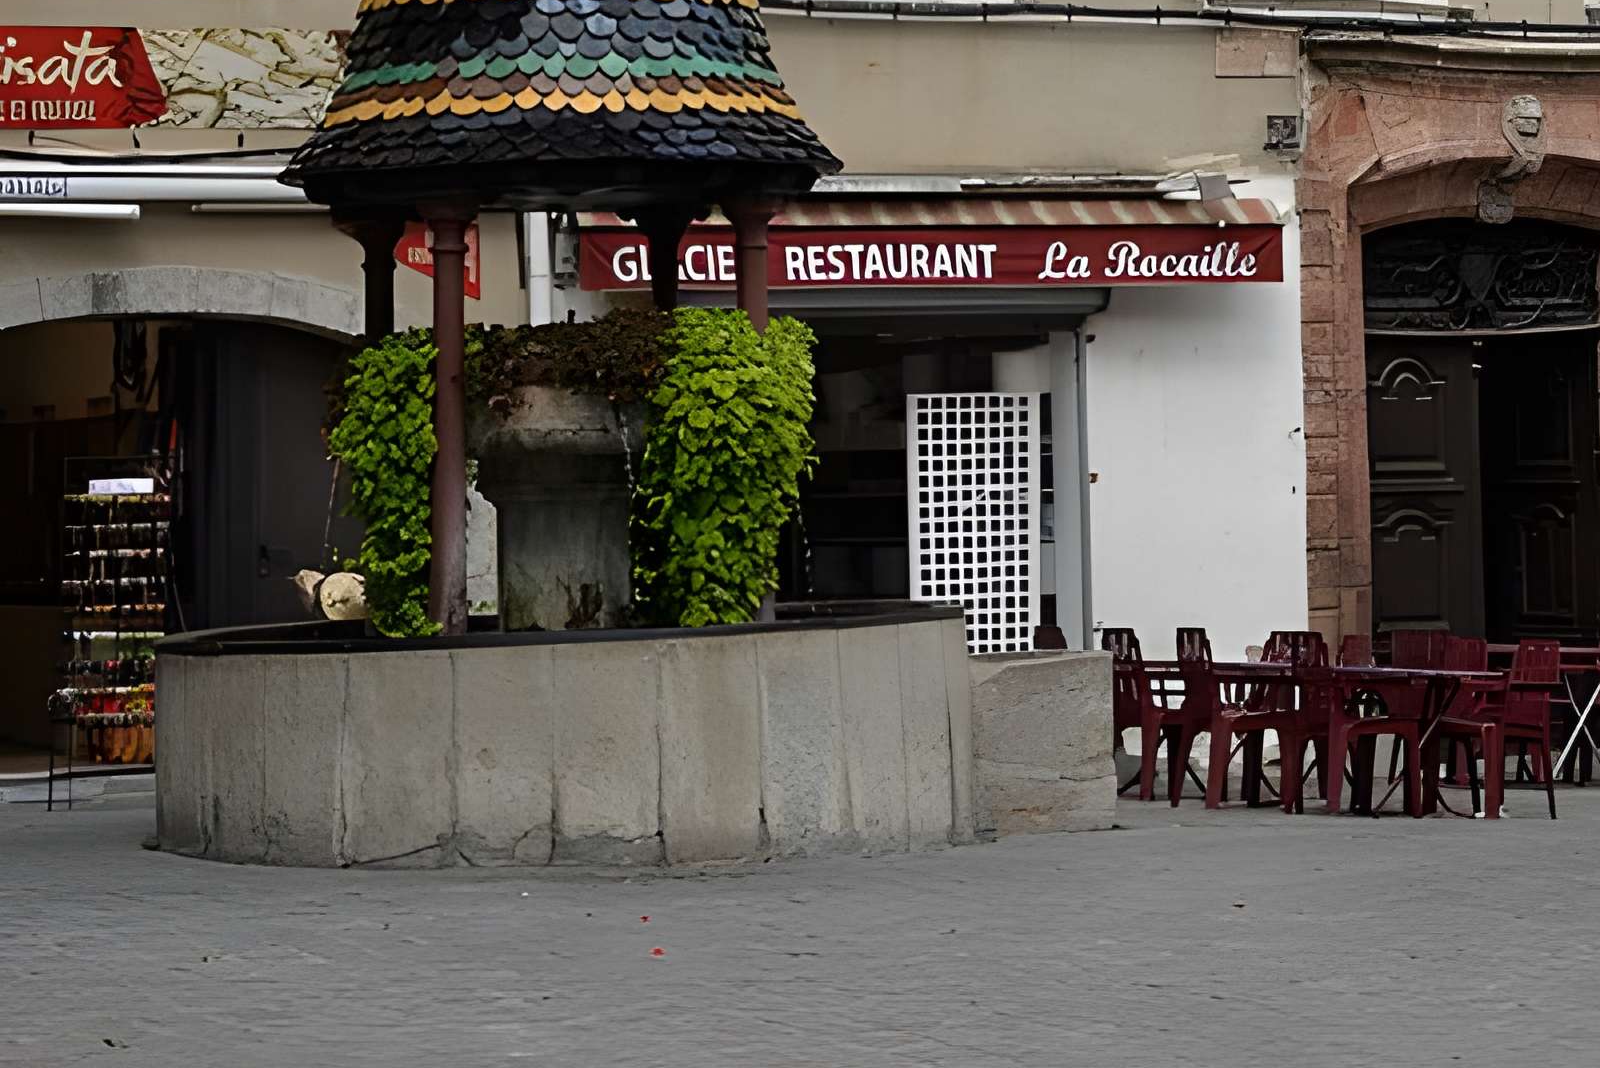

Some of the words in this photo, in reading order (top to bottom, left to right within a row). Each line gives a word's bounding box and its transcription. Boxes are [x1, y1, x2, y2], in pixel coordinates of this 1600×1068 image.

[612, 243, 736, 282] GLCIE
[785, 243, 997, 280] RESTAURANT
[1038, 241, 1091, 280] La
[1104, 240, 1257, 278] Rocaille
